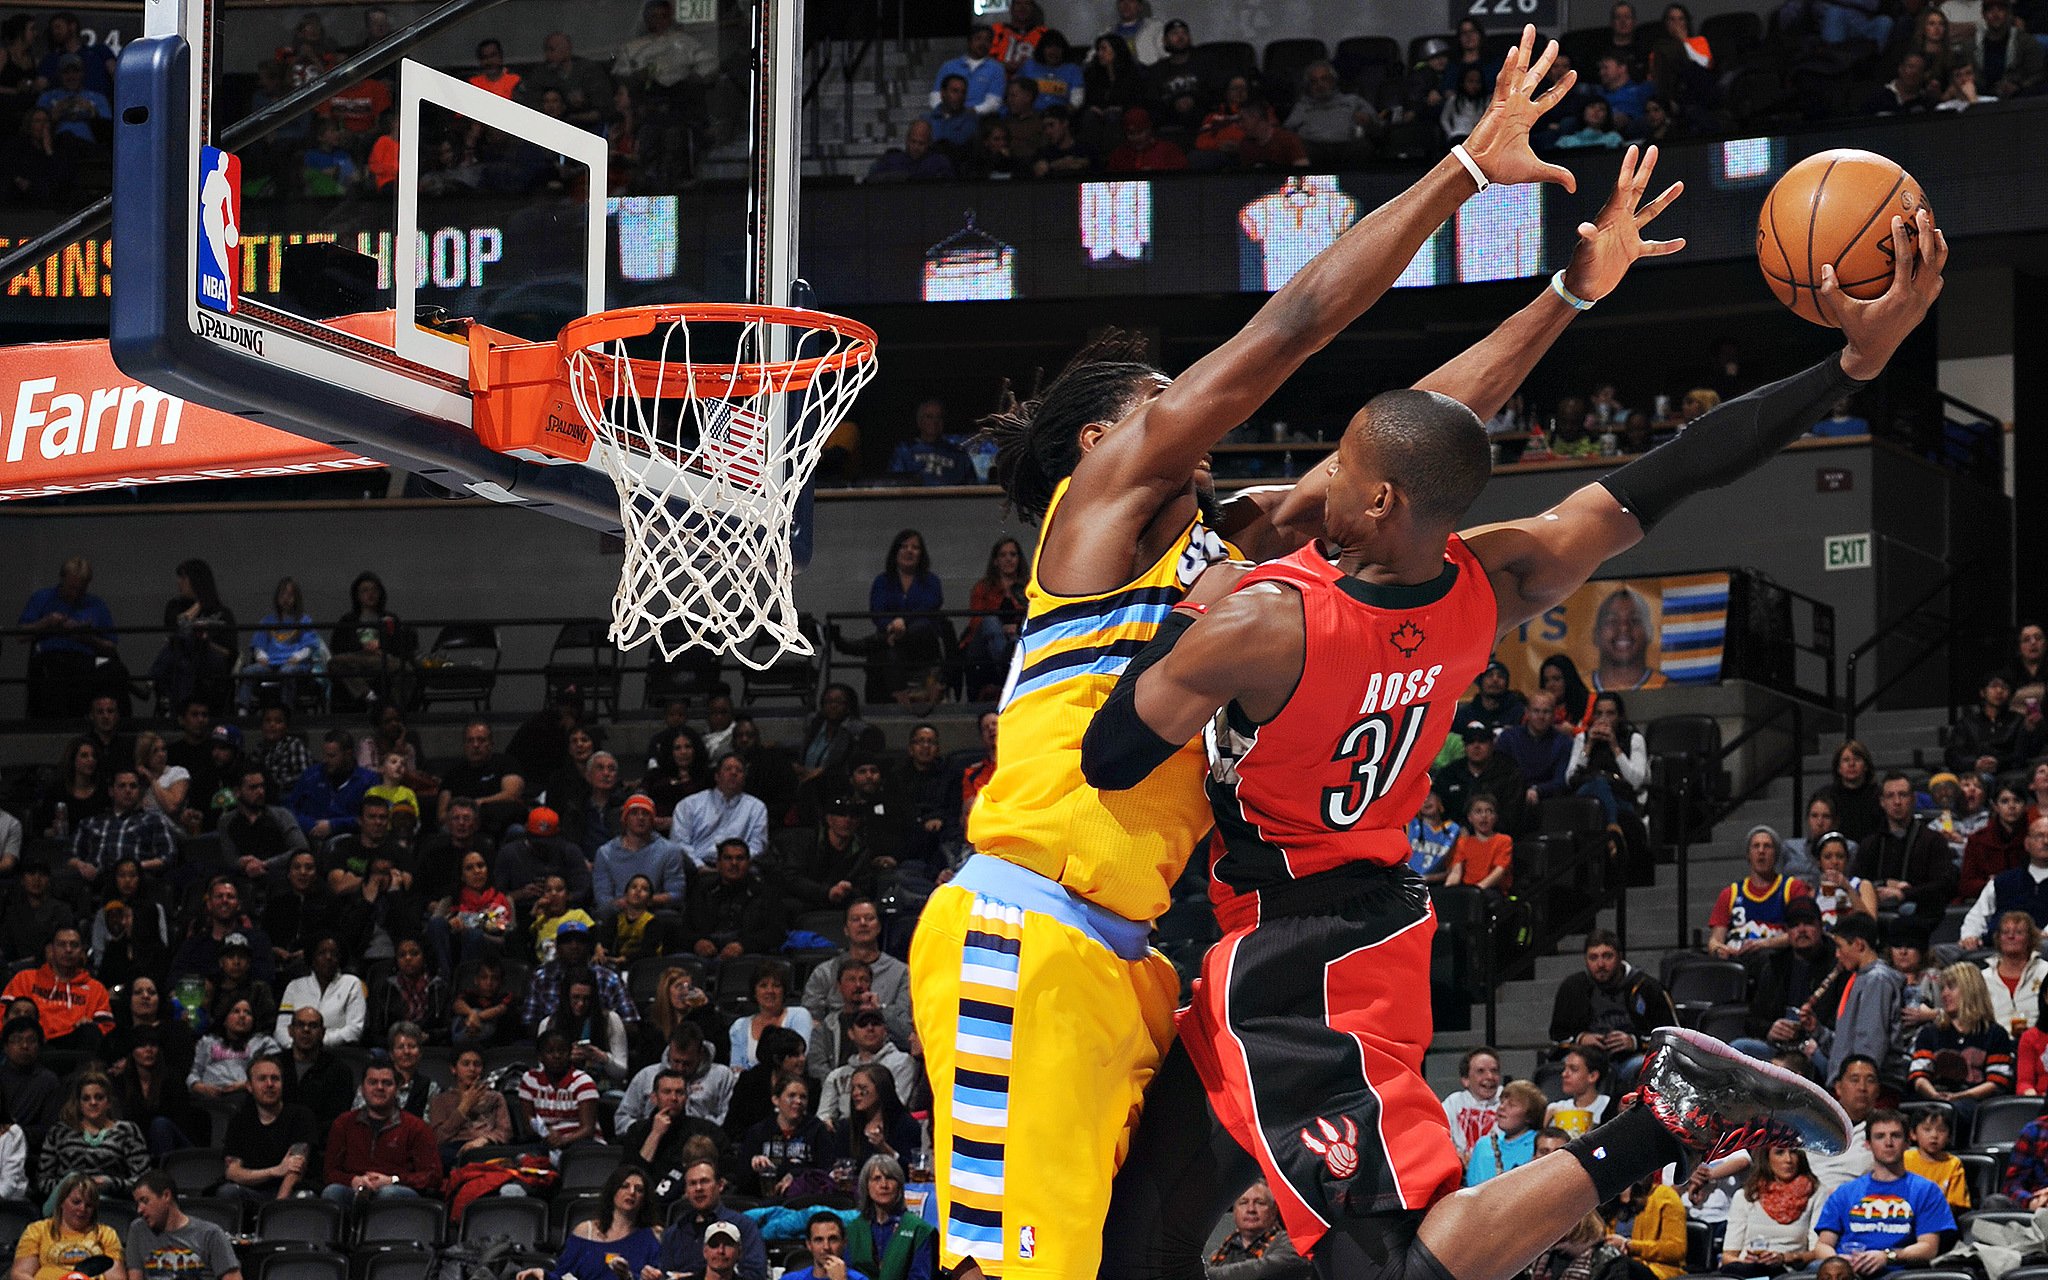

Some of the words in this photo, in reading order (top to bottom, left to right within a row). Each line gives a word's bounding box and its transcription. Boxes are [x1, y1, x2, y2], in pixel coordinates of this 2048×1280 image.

[202, 273, 226, 302] NBA
[197, 310, 265, 357] SPALDING
[1829, 539, 1866, 565] EXIT
[1358, 664, 1443, 715] ROSS
[1320, 701, 1432, 832] 31
